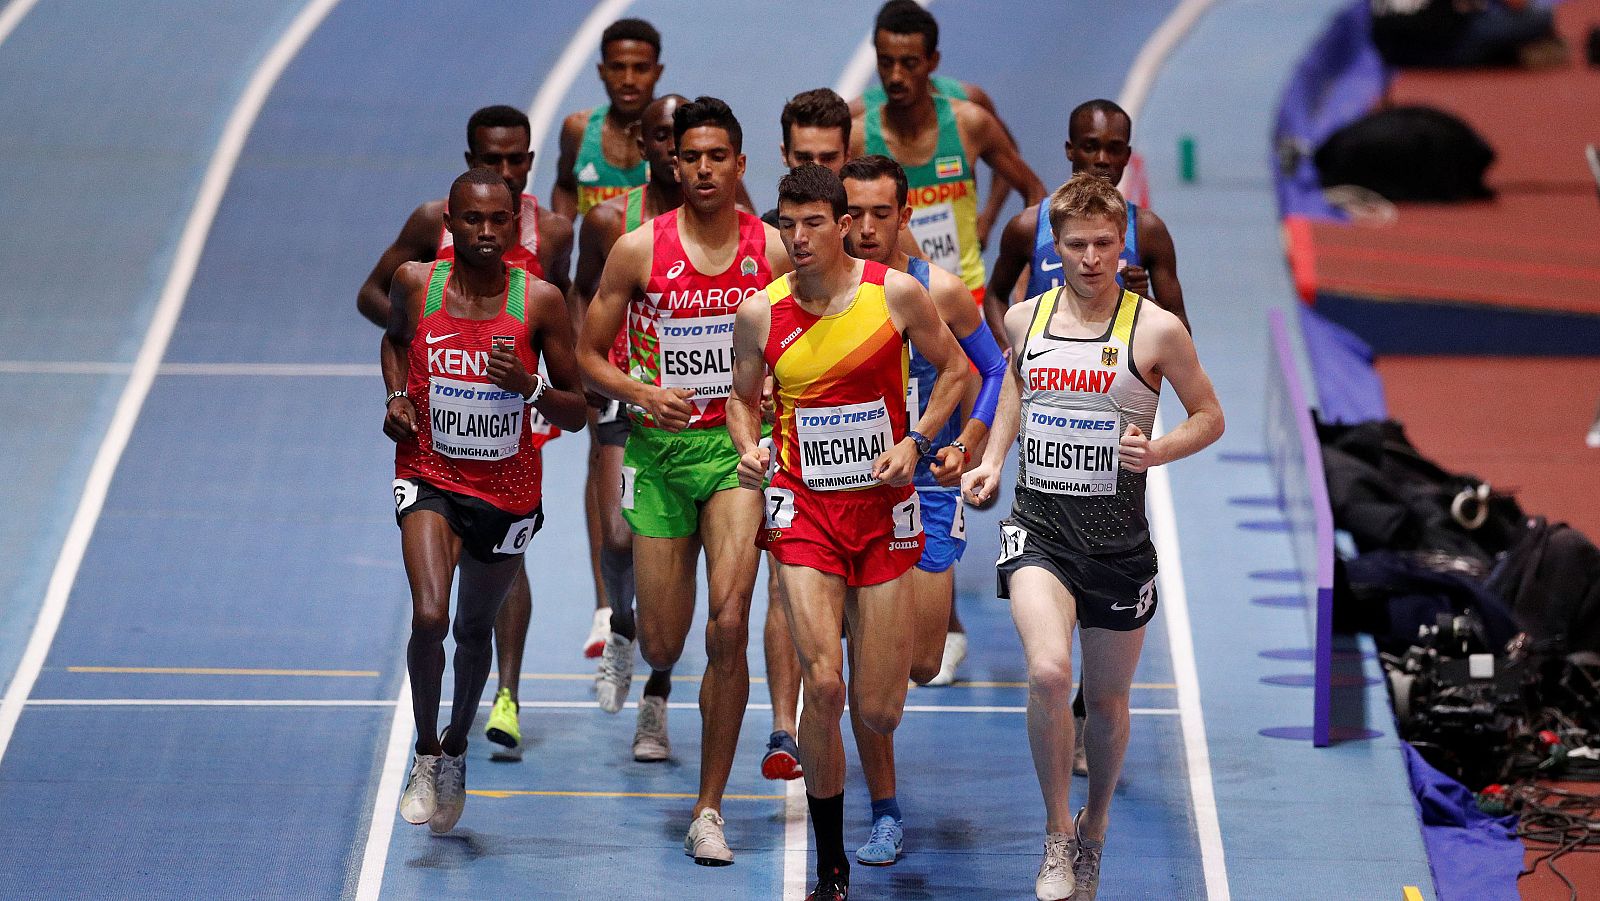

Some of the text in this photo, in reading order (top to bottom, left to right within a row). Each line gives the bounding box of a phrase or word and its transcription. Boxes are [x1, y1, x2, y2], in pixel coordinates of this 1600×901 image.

[907, 181, 967, 208] IOPIA
[922, 234, 955, 260] CHA
[663, 322, 735, 337] TOYO TIRE
[780, 326, 803, 349] Joma
[427, 347, 490, 376] KEN
[1028, 367, 1117, 394] GERMANY
[434, 384, 520, 401] TOYO TIRES
[432, 407, 520, 438] KIPLANGAT
[801, 406, 885, 427] TOYO TIRES
[1031, 412, 1116, 431] TOYO TIRES
[435, 440, 499, 457] BIRMINGHAM
[1027, 437, 1114, 472] BLEISTEIN
[1029, 475, 1113, 493] BIRMINGHAM 2018
[770, 495, 785, 522] 7
[902, 502, 915, 532] 7
[513, 526, 529, 549] 6
[888, 539, 919, 551] Joma
